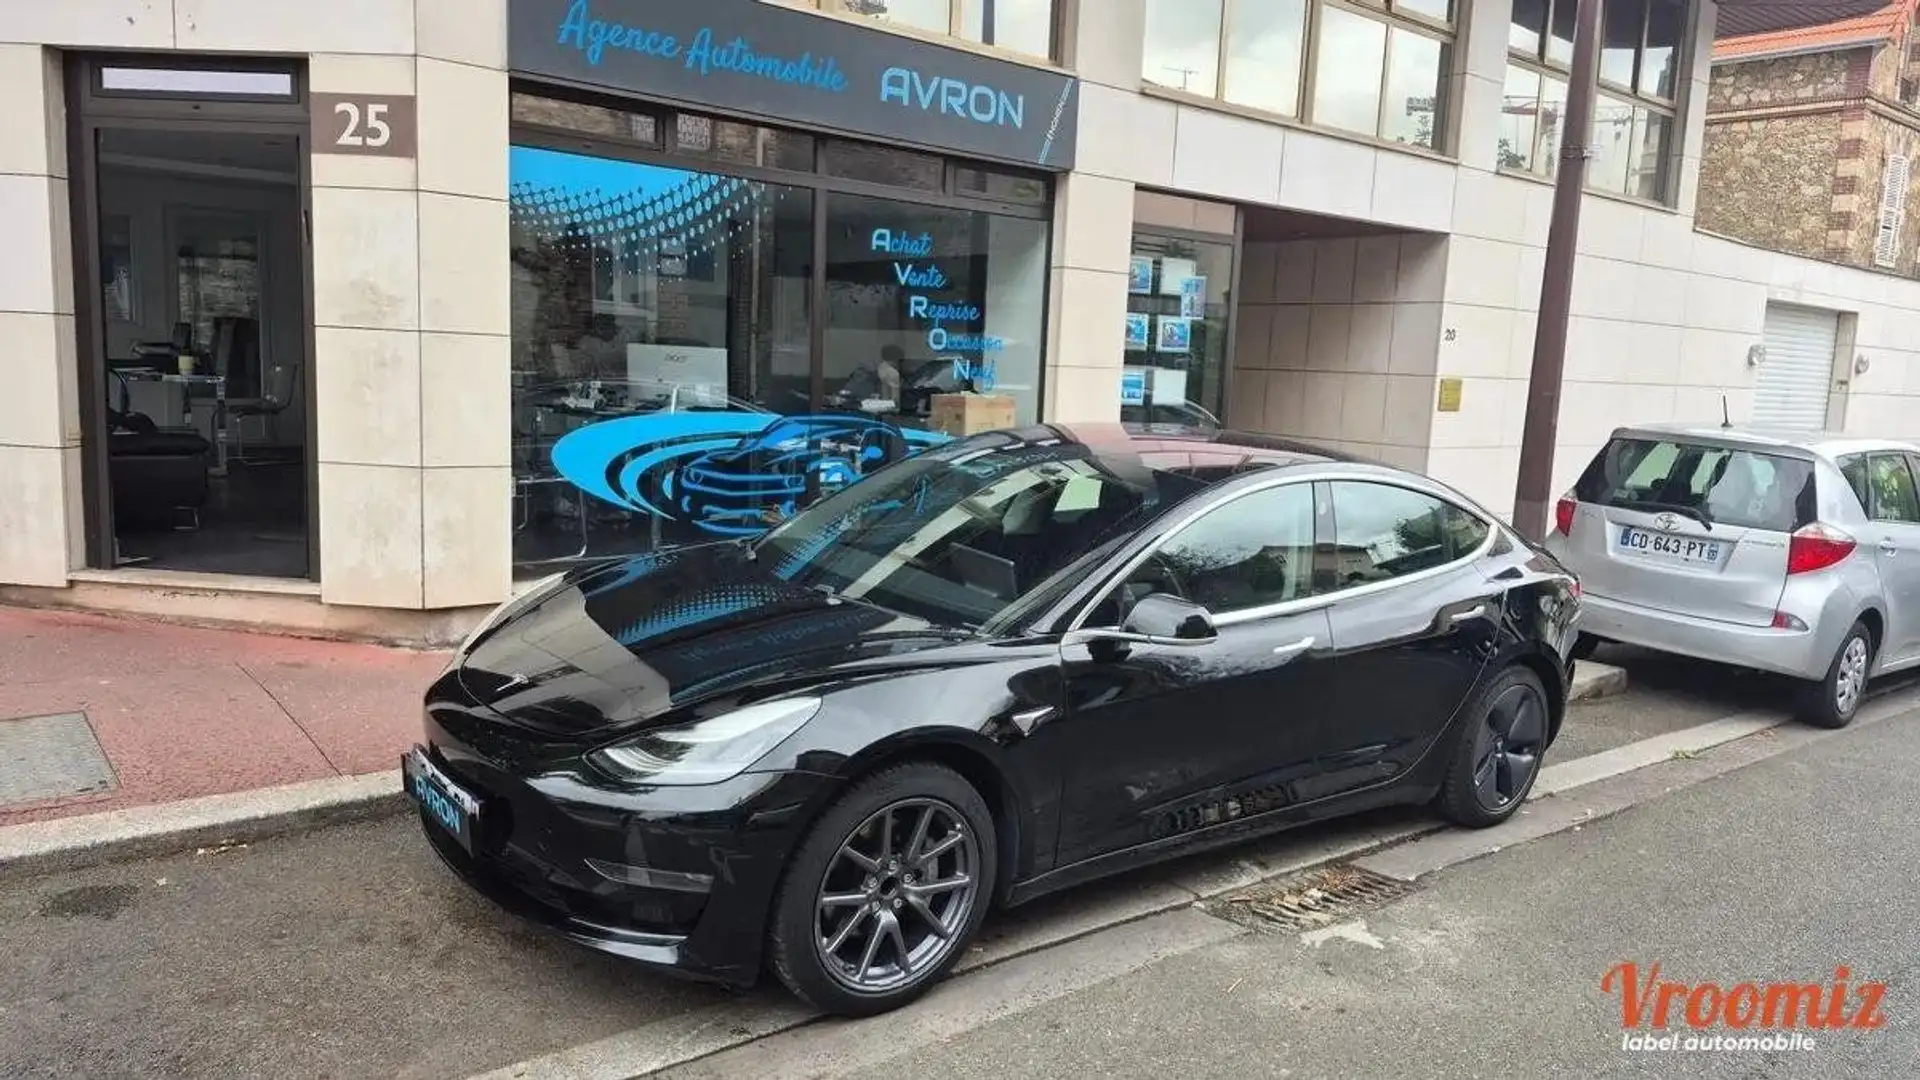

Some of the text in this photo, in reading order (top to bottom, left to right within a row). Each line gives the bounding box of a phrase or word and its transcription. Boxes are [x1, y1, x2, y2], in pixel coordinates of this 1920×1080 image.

[558, 0, 848, 91] Agence Automobile
[880, 67, 1024, 129] AVRON
[334, 103, 390, 146] 25
[872, 228, 932, 257] Achat
[894, 262, 947, 289] Vente
[910, 296, 980, 327] Reprise
[953, 358, 997, 391] Neuf
[1631, 533, 1707, 557] CD-643-PT
[416, 775, 461, 834] AVRON
